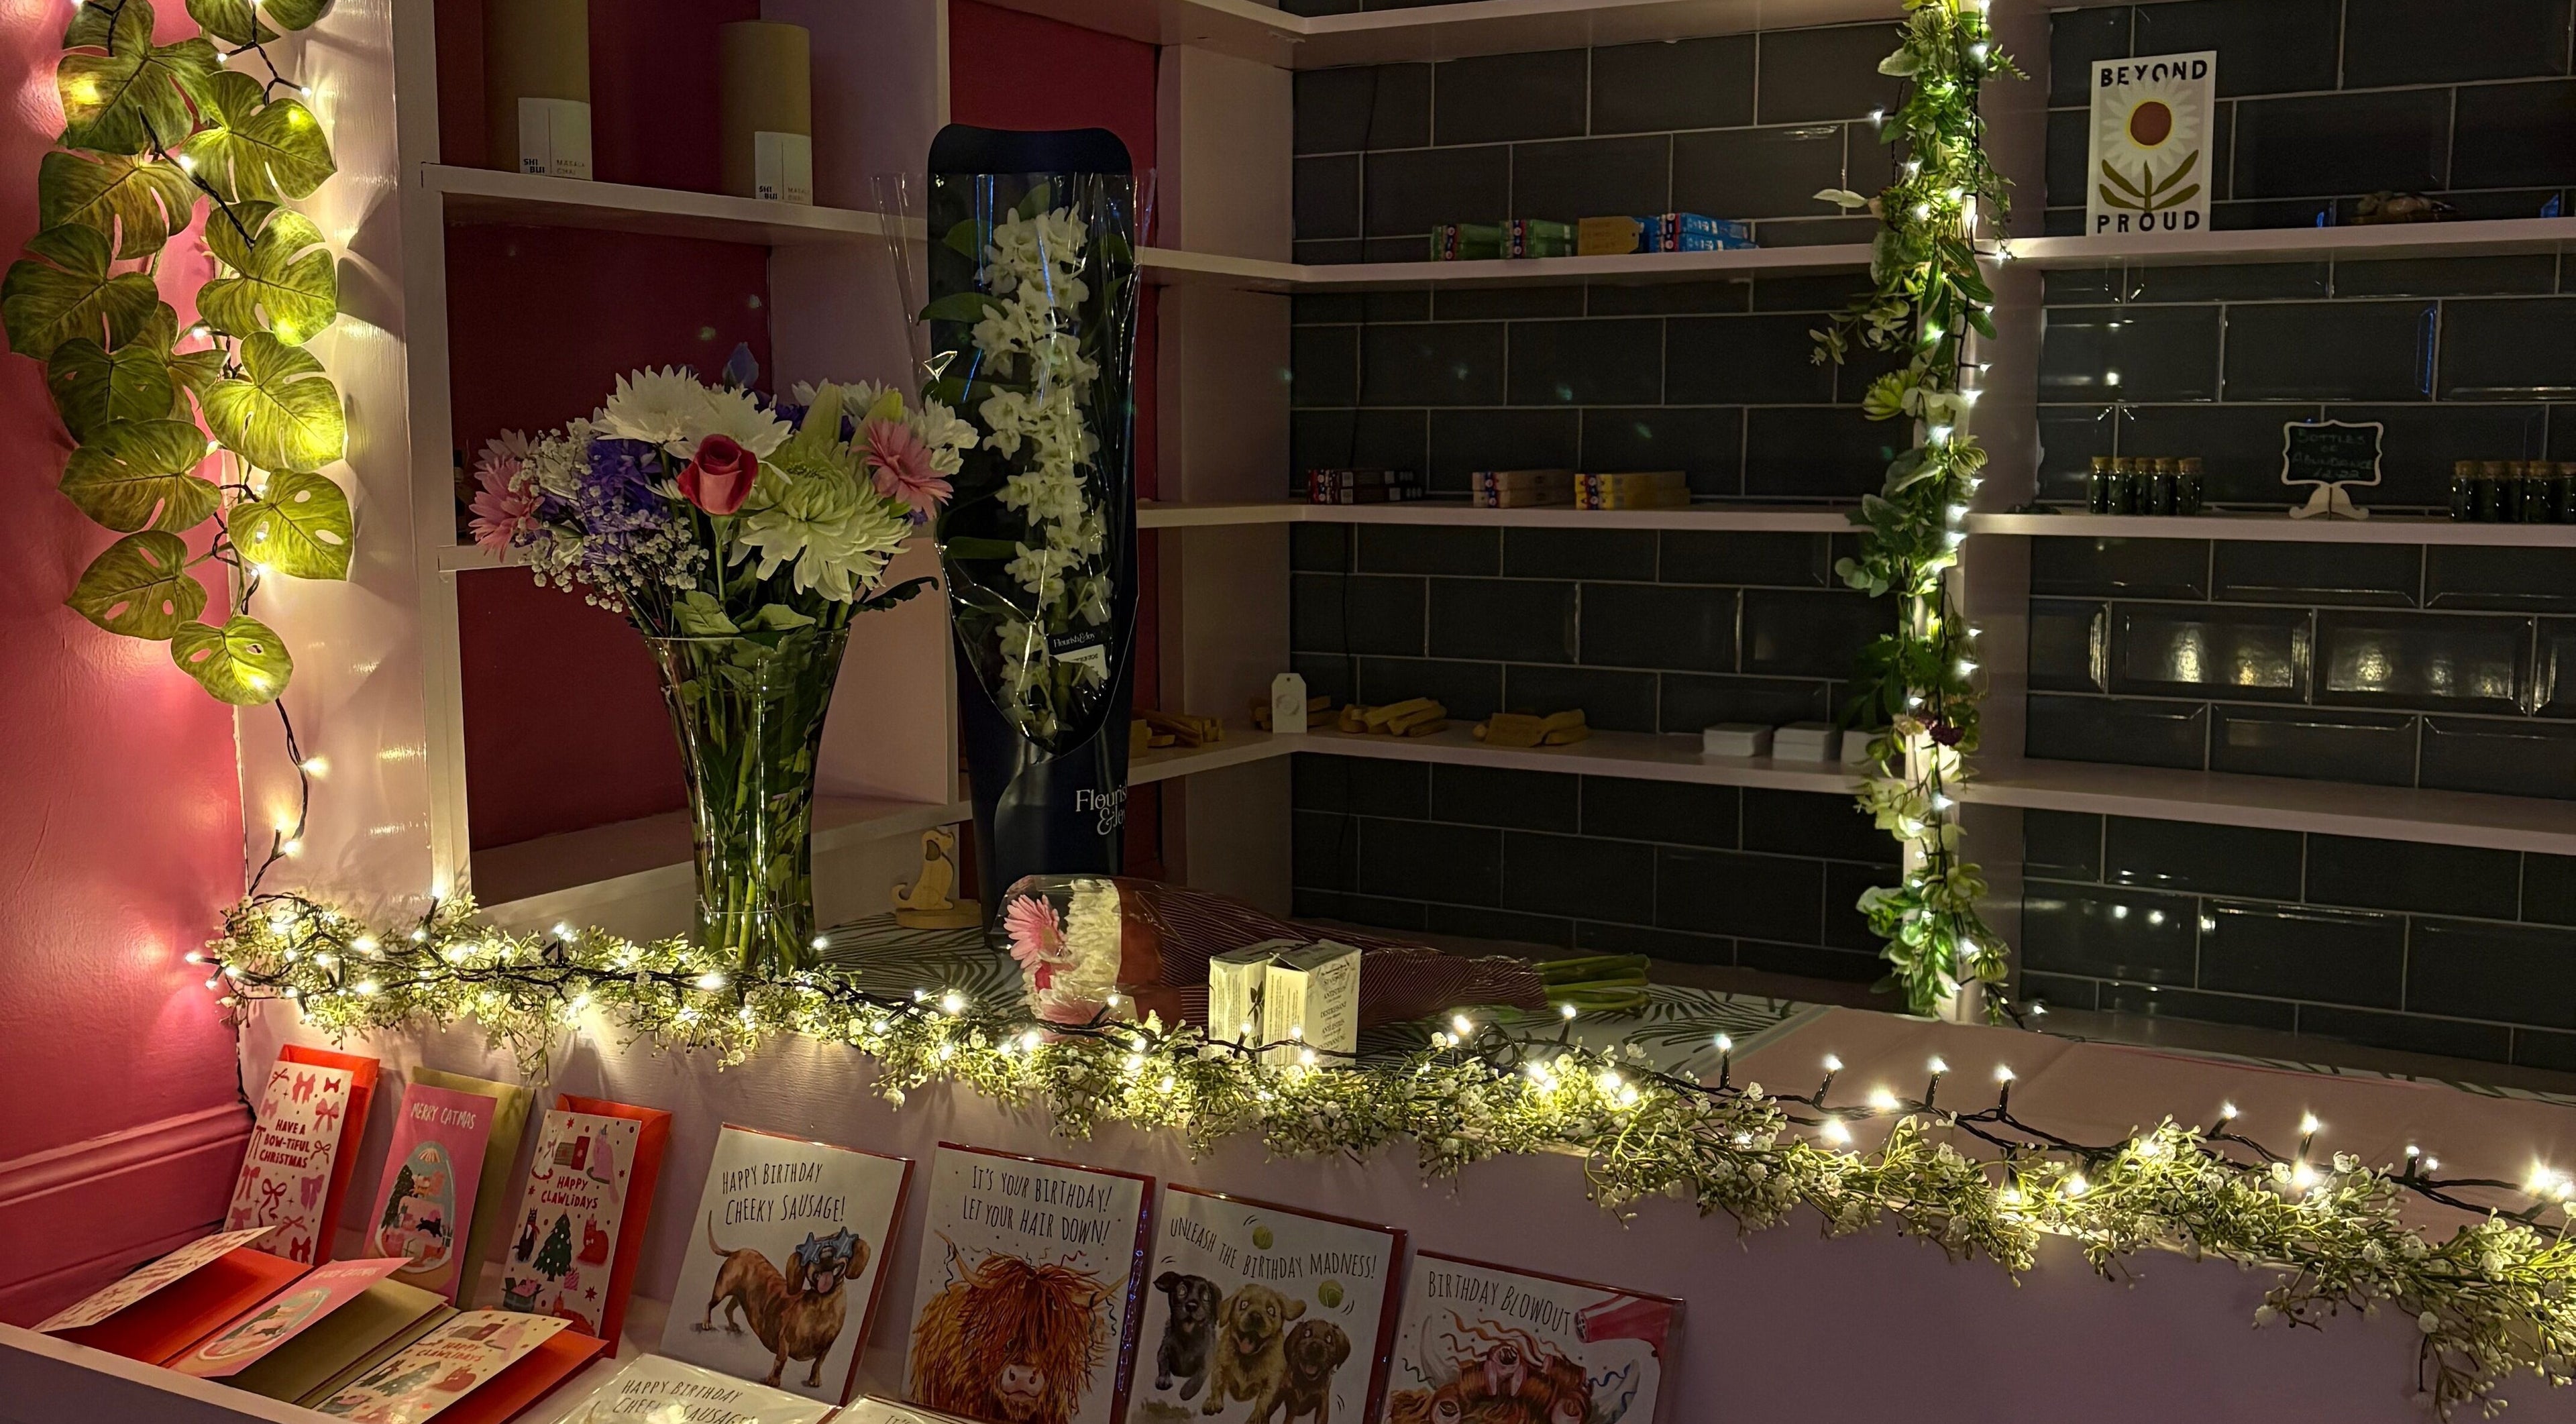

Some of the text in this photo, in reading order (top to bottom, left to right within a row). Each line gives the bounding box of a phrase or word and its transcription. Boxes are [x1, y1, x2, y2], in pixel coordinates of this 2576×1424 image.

[2100, 60, 2208, 87] BEYOND
[2097, 210, 2200, 234] PROUD
[1075, 779, 1127, 812] Flouris
[275, 1119, 306, 1135] HAVE A
[411, 1102, 476, 1130] MERRY CATMAS
[556, 1176, 589, 1191] HAPPY
[722, 1162, 823, 1195] HAPPY BIRTHDAY
[972, 1165, 1112, 1213] IT'S YOUR BIRTHDAY!
[725, 1193, 846, 1225] CHEEKY SAUSAGE!
[963, 1195, 1111, 1246] LET YOUR HAIR DOWN!
[1170, 1217, 1377, 1280] UNLEASH THE BIRTHDAY MADNESS!
[1428, 1270, 1571, 1335] BIRTHDAY BLOWOUT
[621, 1379, 744, 1404] HAPPY BIRTHDAY
